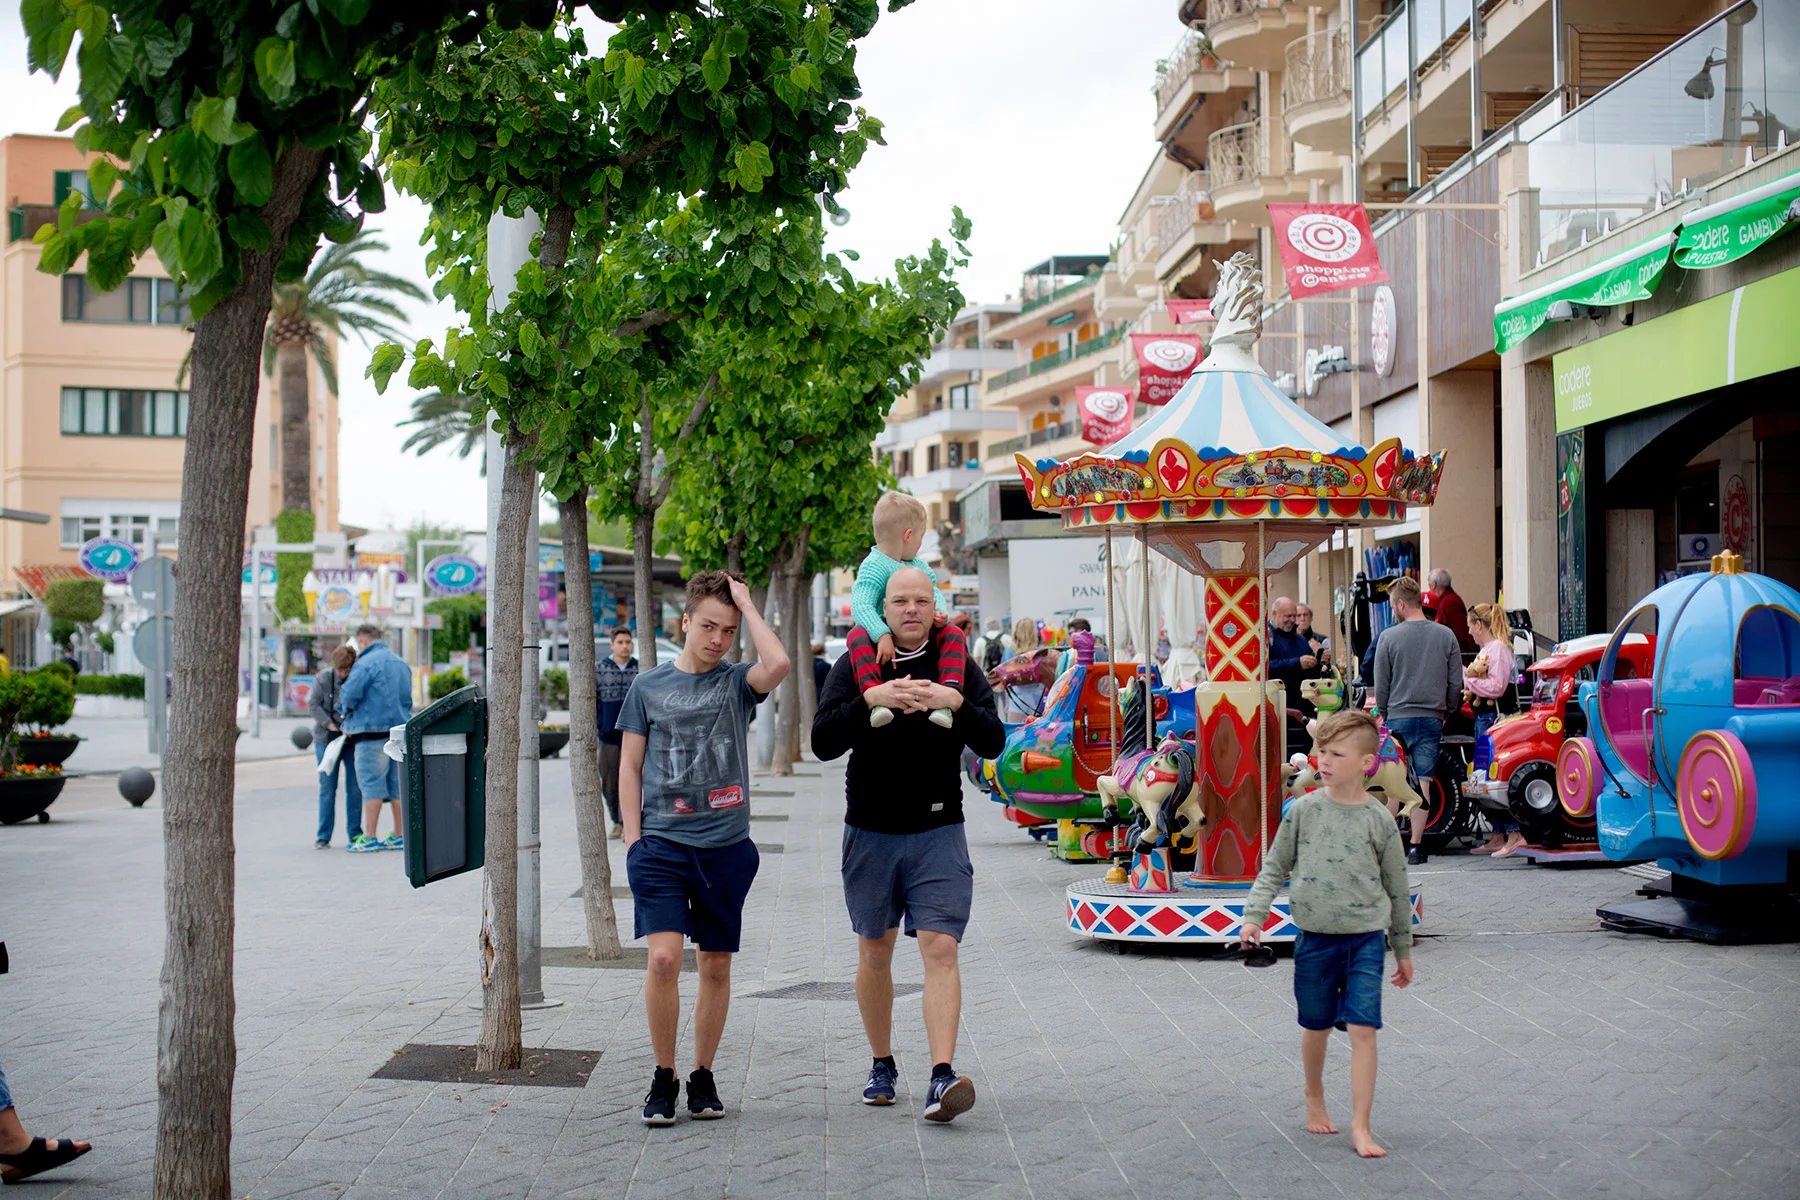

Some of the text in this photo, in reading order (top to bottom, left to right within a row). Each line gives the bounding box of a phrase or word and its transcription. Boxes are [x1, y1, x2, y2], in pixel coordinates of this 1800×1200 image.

[1680, 248, 1730, 265] APUESTAS
[1295, 264, 1371, 276] shopping
[1500, 314, 1528, 338] codere
[1558, 363, 1593, 396] codere
[1571, 391, 1593, 413] JUEGOS
